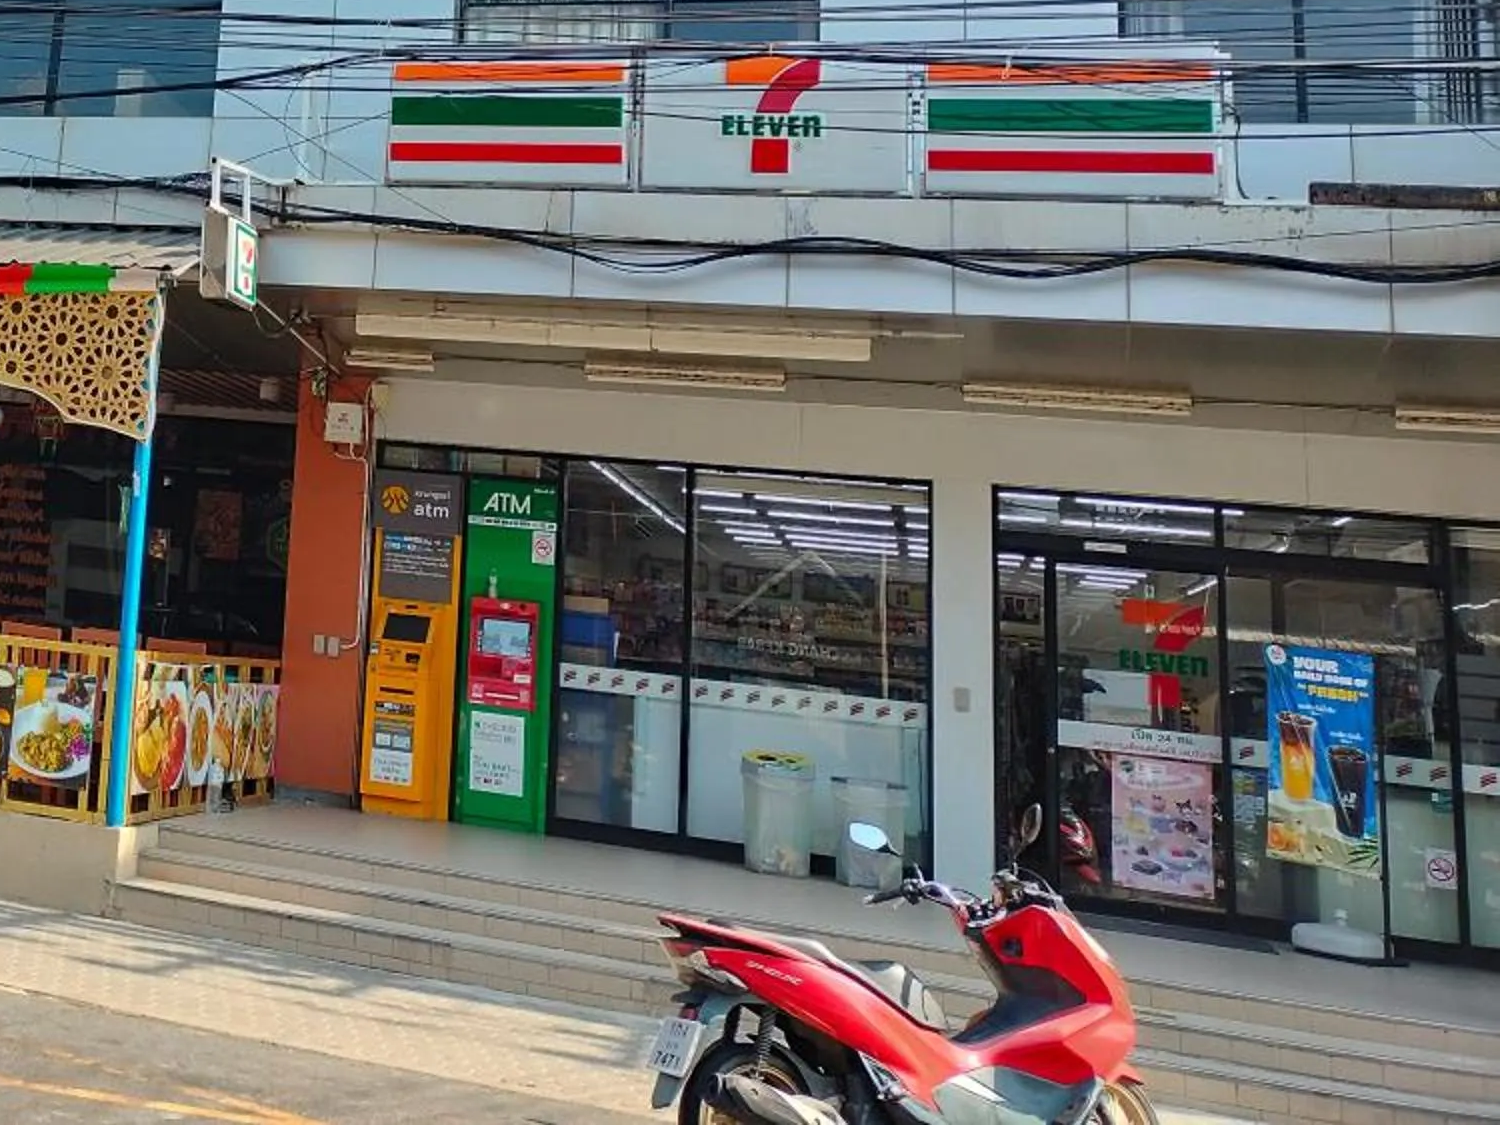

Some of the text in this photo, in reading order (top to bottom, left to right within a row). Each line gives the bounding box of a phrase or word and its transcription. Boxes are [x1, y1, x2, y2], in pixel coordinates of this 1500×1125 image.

[414, 503, 450, 519] atm
[483, 492, 532, 516] ATM
[1293, 656, 1339, 674] YOUR
